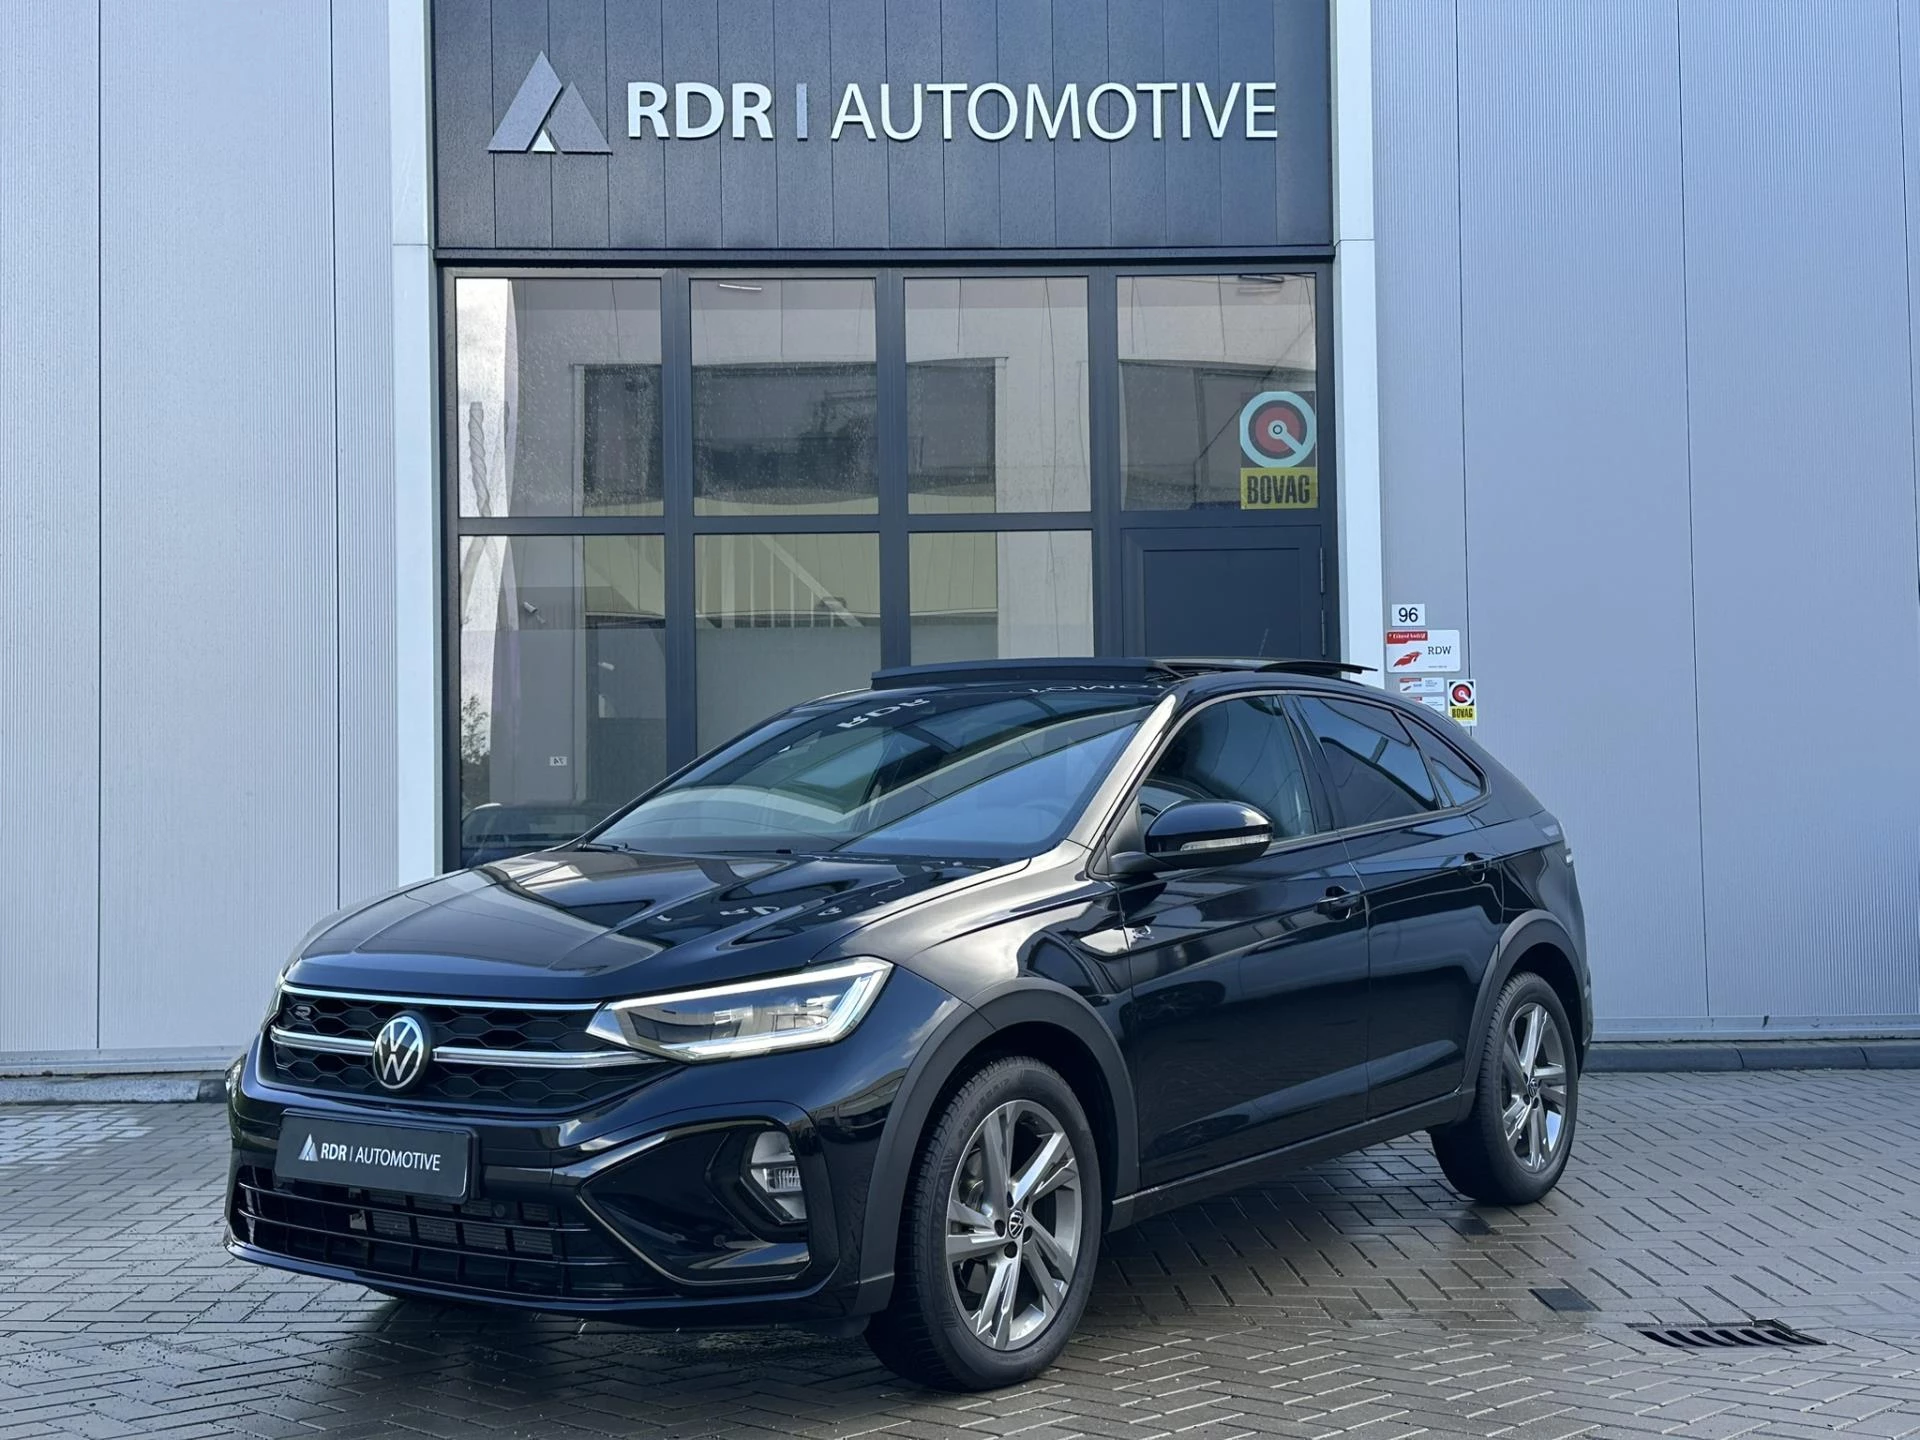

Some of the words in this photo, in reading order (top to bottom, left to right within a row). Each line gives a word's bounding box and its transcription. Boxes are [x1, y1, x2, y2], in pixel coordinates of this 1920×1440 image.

[627, 82, 773, 140] RDR
[830, 82, 1279, 141] AUTOMOTIVE
[1246, 474, 1311, 505] BOVAG
[1398, 606, 1419, 623] 96
[1427, 645, 1452, 655] RDW
[1451, 708, 1473, 719] BOVAG
[374, 1016, 424, 1089] VW
[320, 1142, 348, 1161] RDR
[355, 1146, 441, 1172] AUTOMOTIVE
